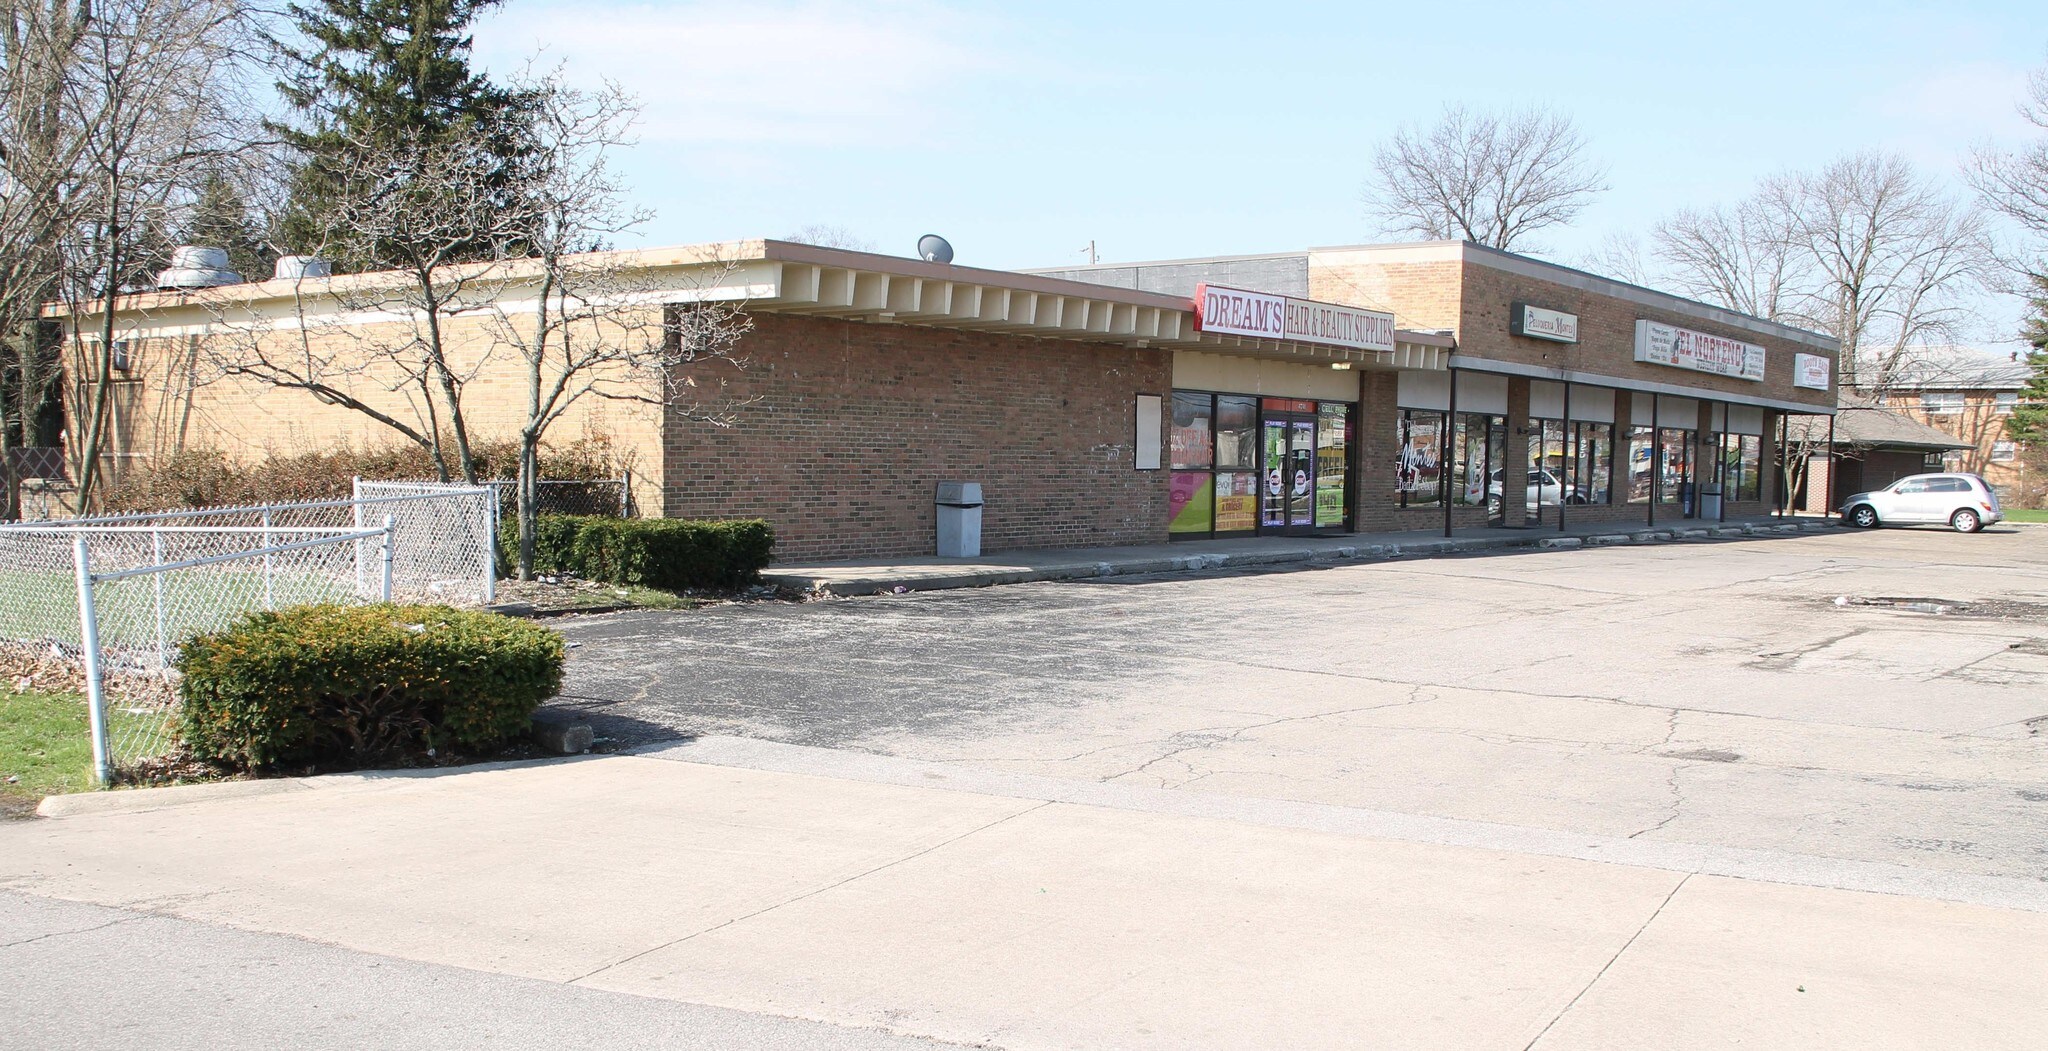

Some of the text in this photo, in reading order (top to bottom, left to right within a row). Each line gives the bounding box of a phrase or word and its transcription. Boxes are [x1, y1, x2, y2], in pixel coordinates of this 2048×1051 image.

[1205, 293, 1282, 333] DREAM'S
[1286, 304, 1393, 346] HAIR & BEAUTY SUPPLIES
[1679, 331, 1691, 356] EL
